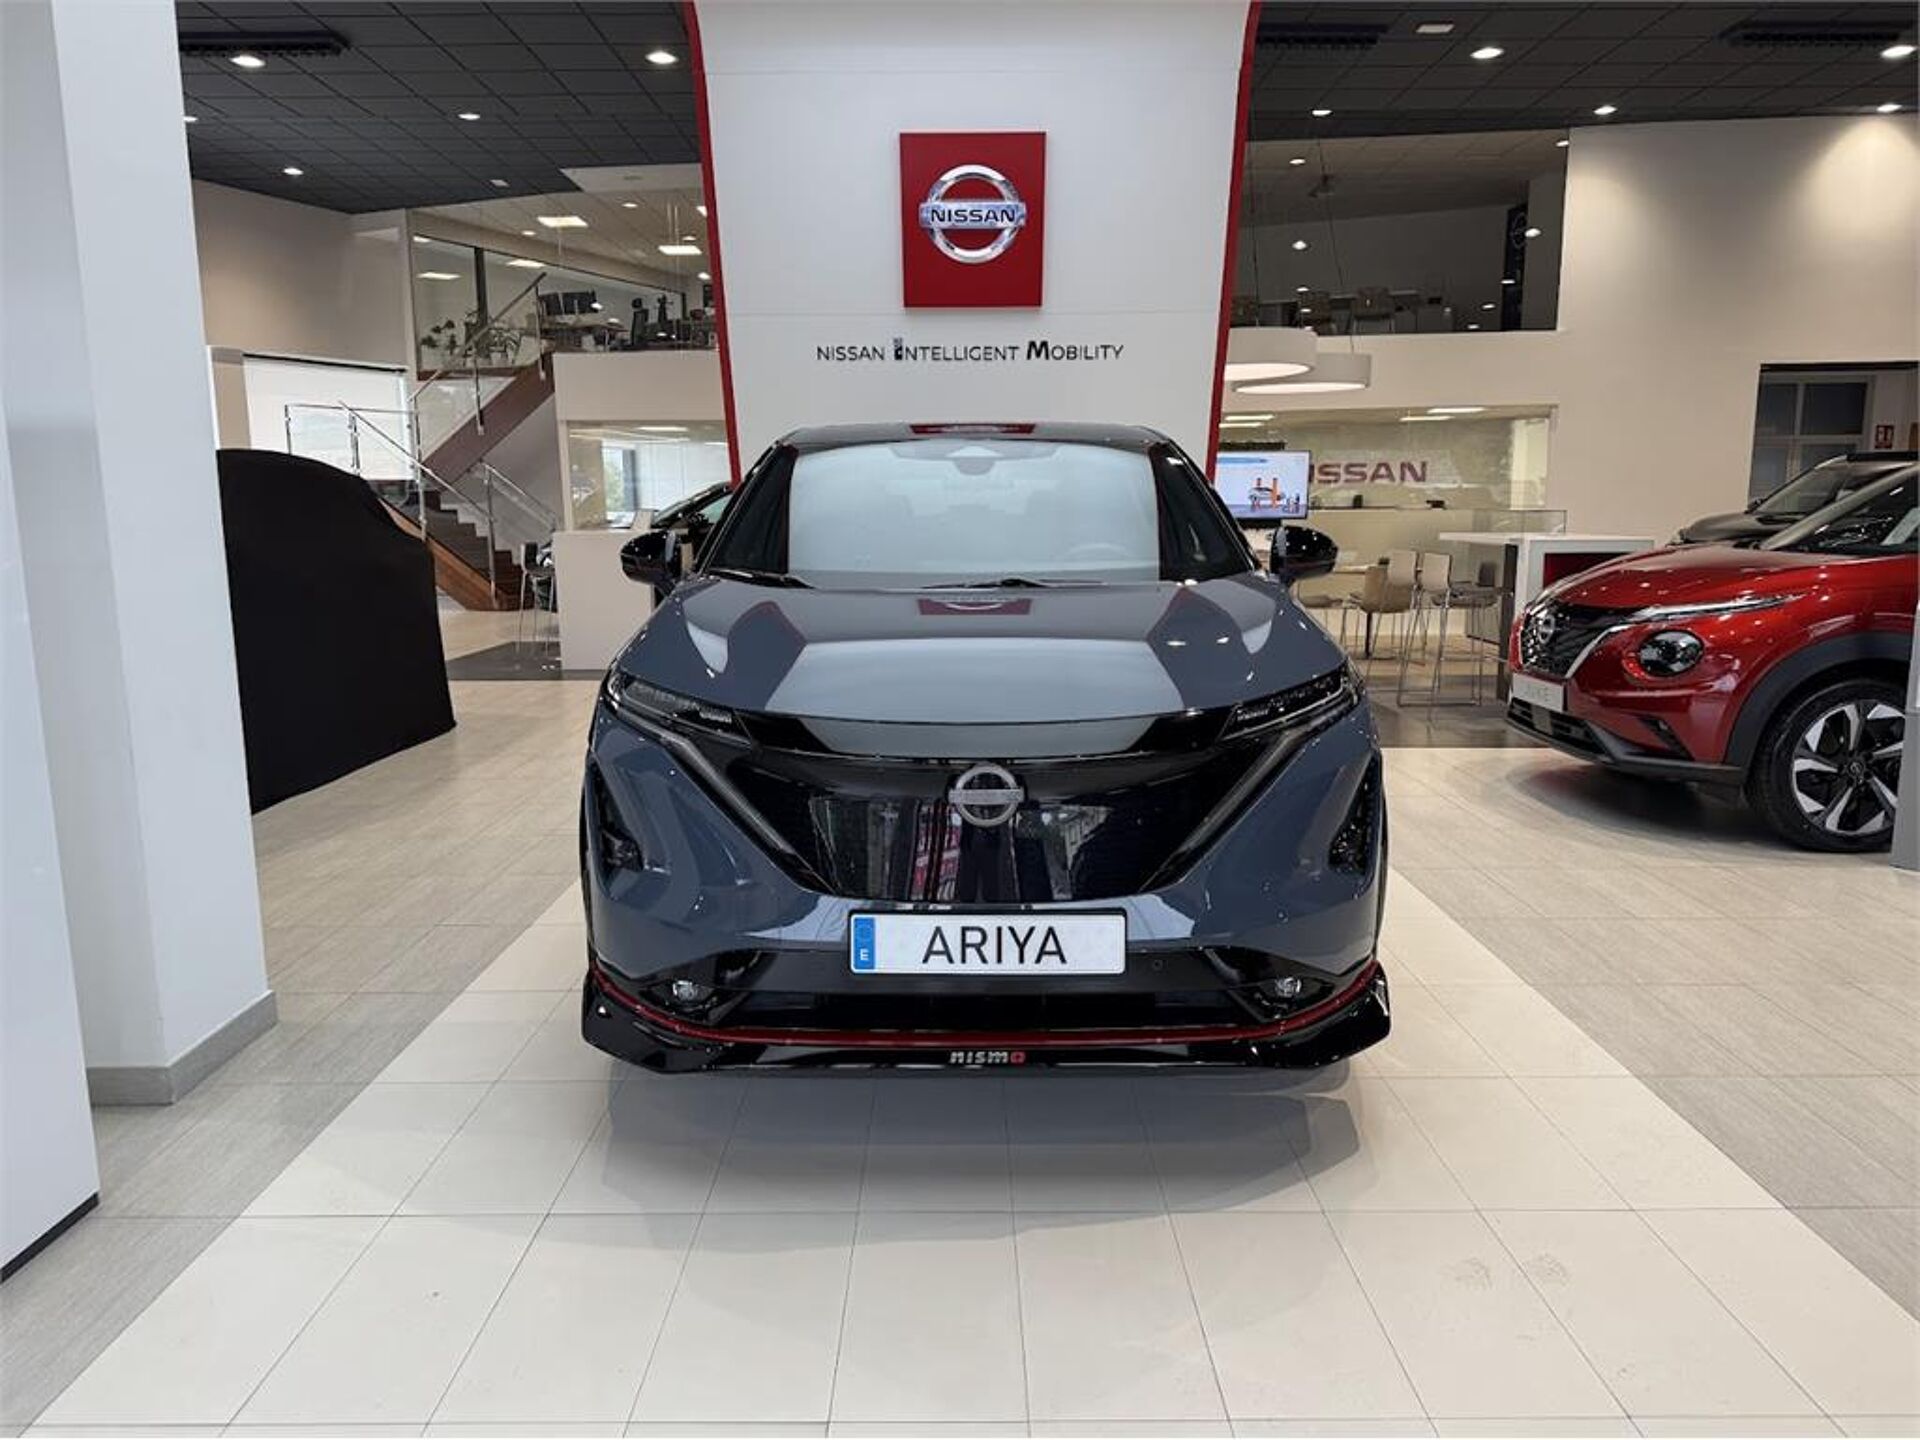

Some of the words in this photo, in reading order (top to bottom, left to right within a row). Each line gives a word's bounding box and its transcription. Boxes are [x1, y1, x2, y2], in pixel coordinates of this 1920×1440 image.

[931, 209, 1015, 222] NISSAN
[816, 346, 885, 361] NISSAN
[1308, 461, 1427, 483] ISSAN
[860, 948, 869, 961] E
[922, 926, 1067, 964] ARIYA
